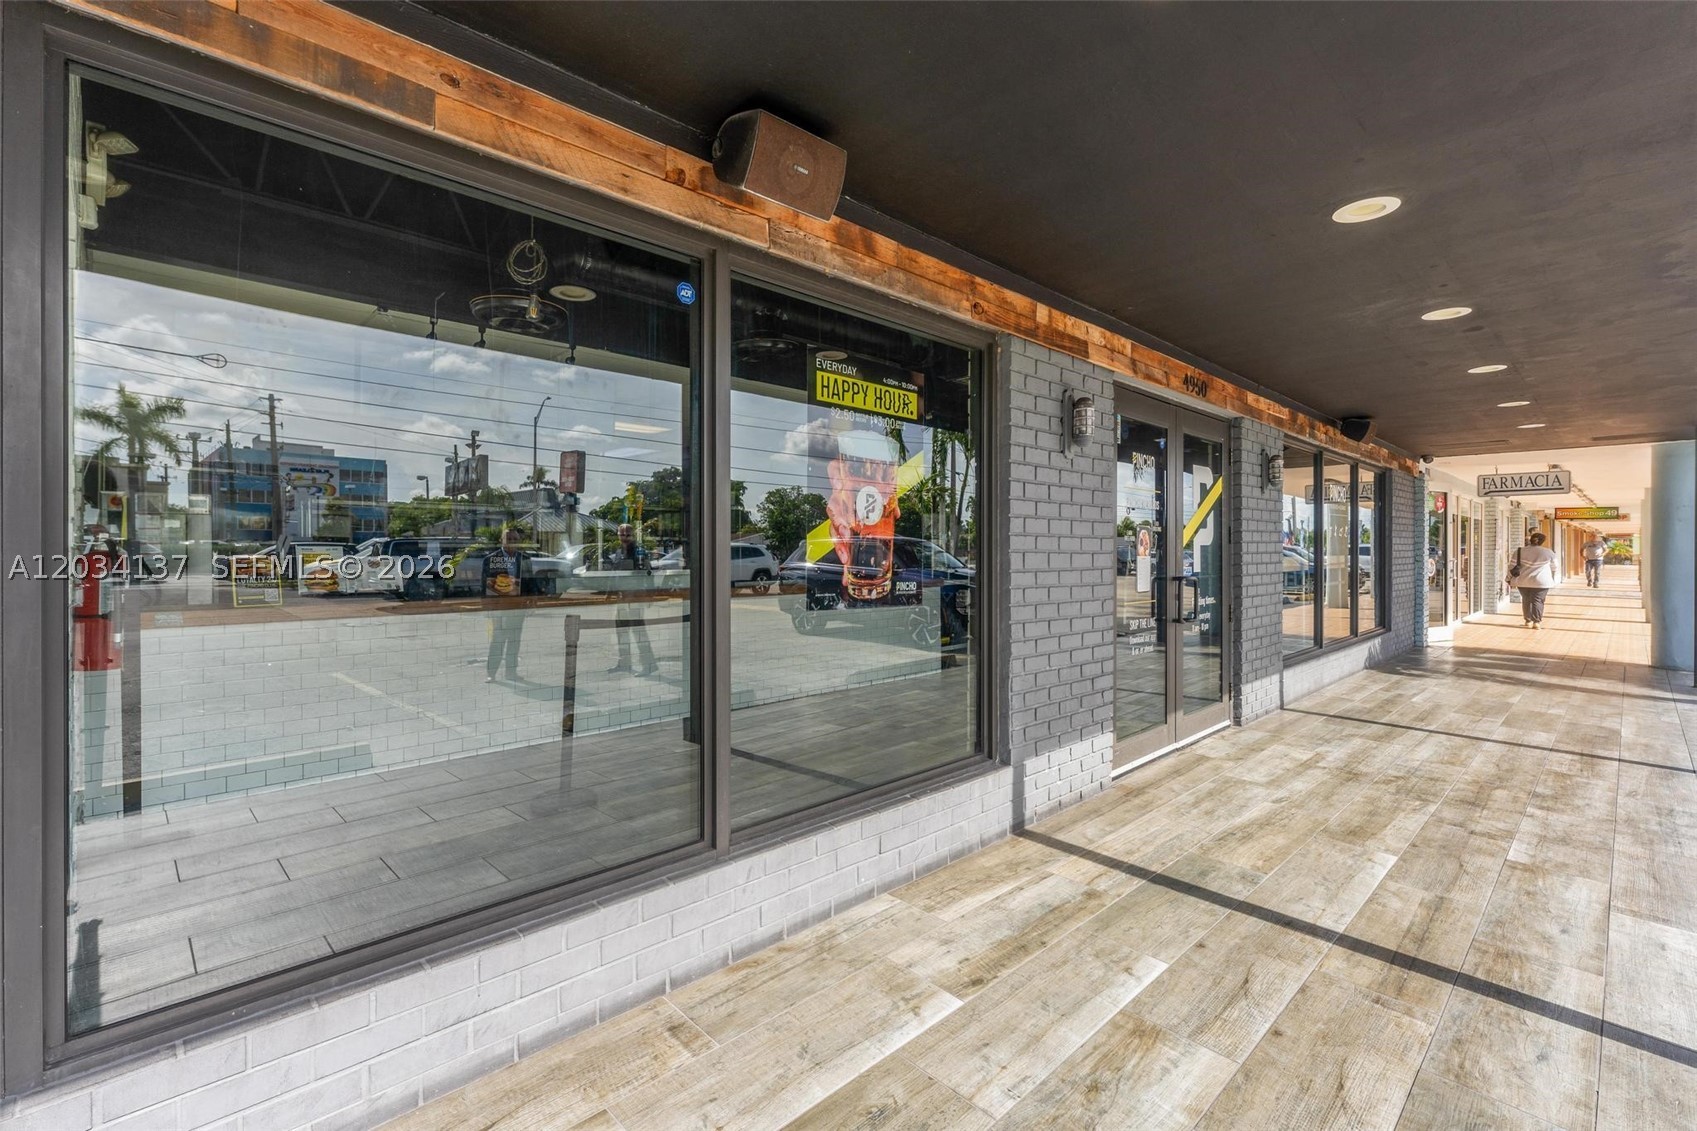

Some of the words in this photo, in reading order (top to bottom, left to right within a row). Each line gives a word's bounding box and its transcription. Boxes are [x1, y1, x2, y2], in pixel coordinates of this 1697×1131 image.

[816, 358, 857, 376] EVERYDAY
[1183, 373, 1207, 398] 4950
[821, 375, 869, 406] HAPPY
[874, 387, 914, 416] HOUR.
[830, 406, 855, 421] $2.50
[1132, 451, 1156, 470] PINCHO
[1482, 474, 1562, 490] FARMACIA
[1584, 509, 1605, 517] Shop
[1605, 509, 1618, 517] 49
[896, 581, 917, 591] PINCHO
